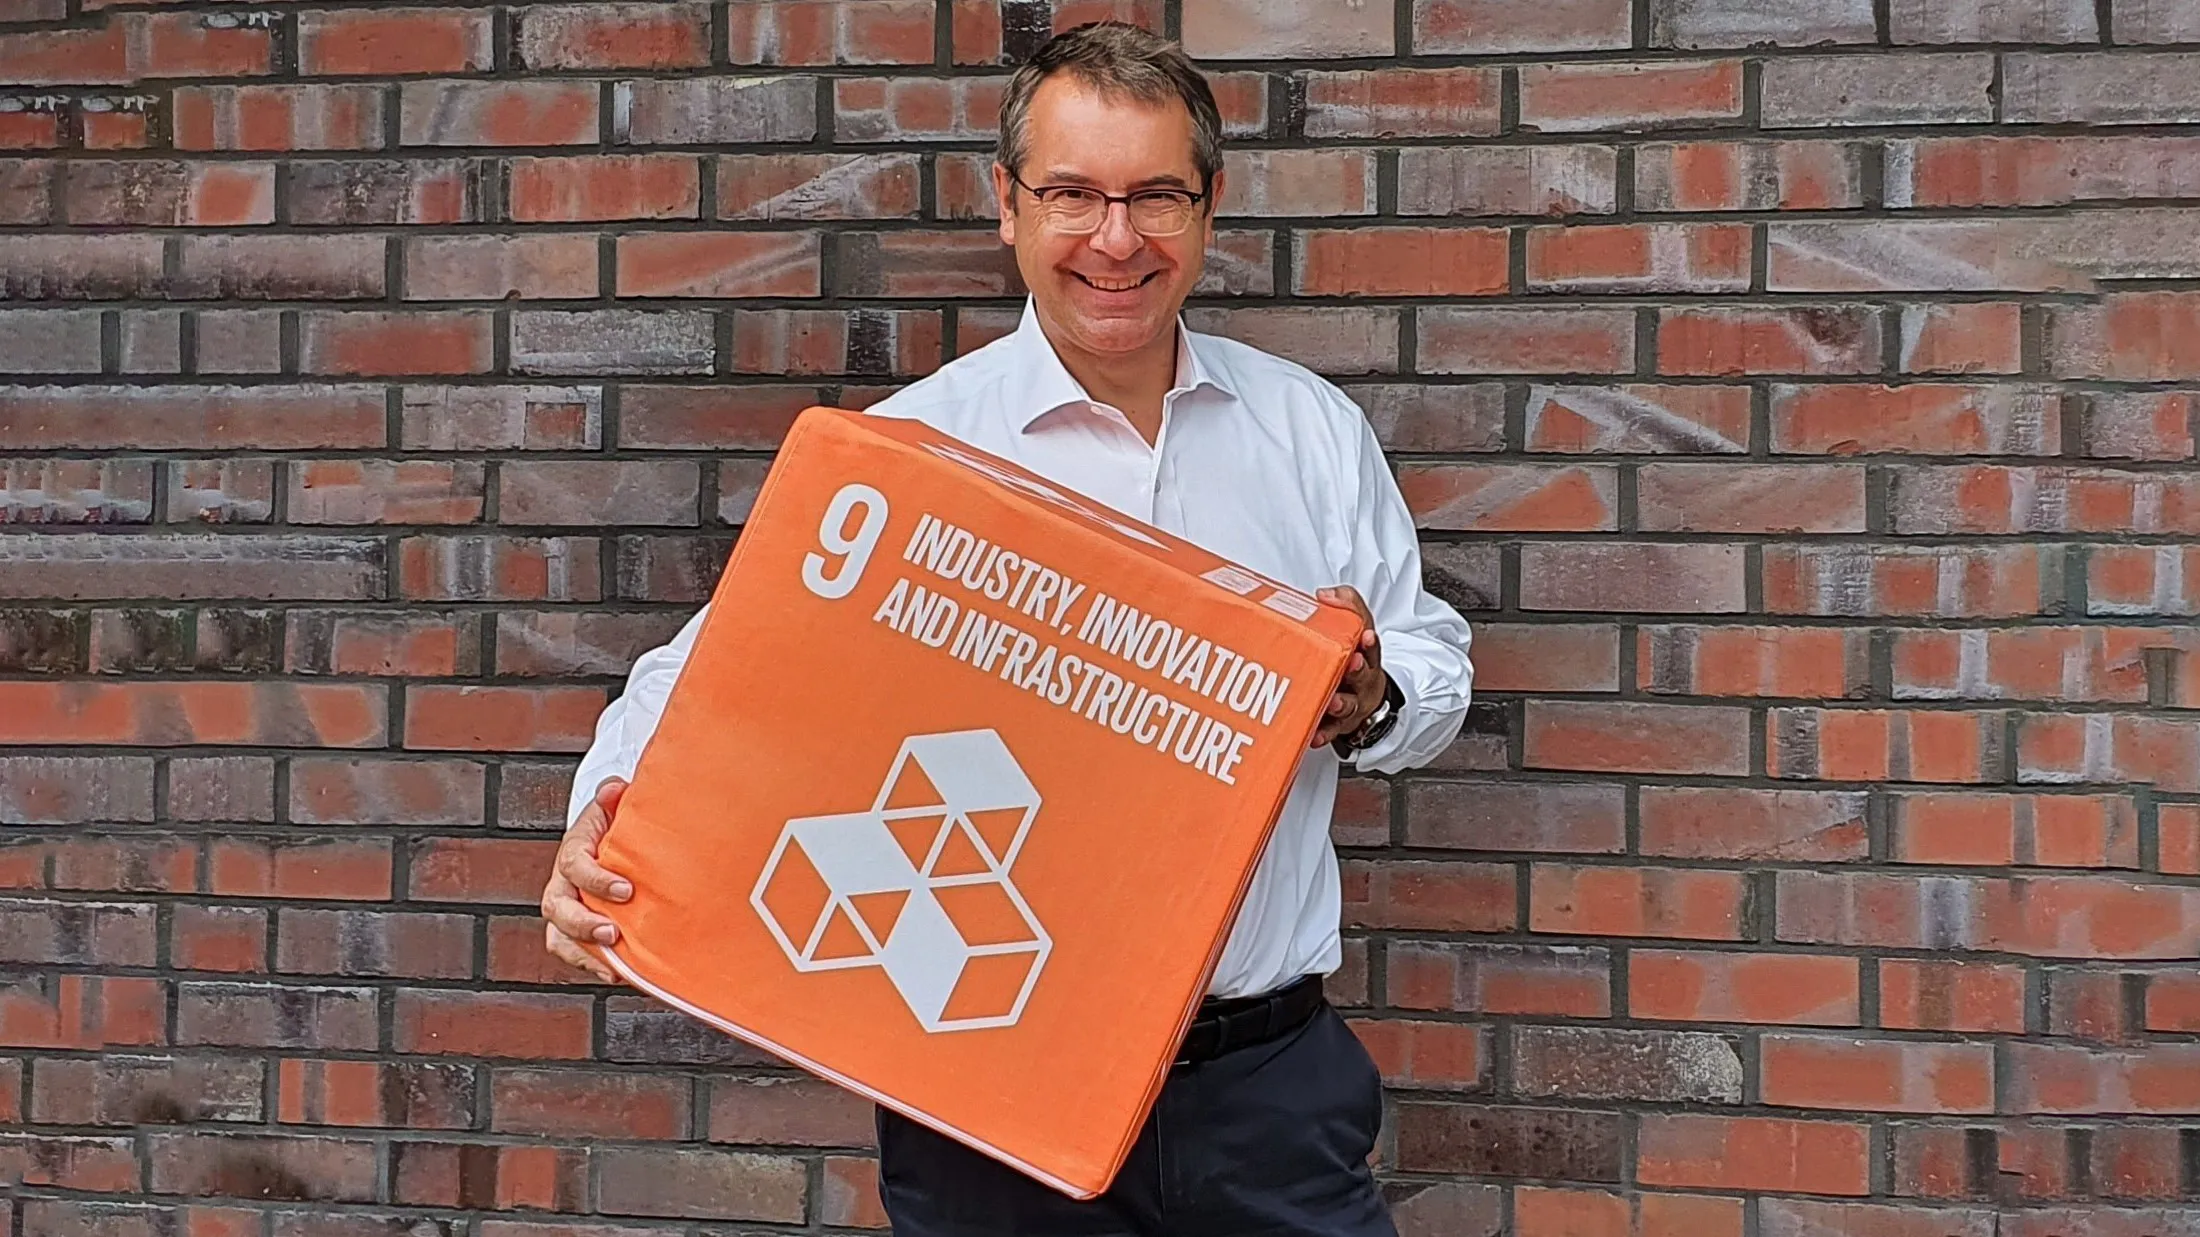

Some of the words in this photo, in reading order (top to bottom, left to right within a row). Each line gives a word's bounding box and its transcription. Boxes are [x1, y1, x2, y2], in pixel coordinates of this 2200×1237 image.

[801, 483, 889, 600] 9
[902, 512, 1087, 637] INDUSTRY,
[1077, 592, 1291, 726] INNOVATION
[872, 577, 960, 648] AND
[949, 608, 1254, 786] INFRASTRUCTURE
